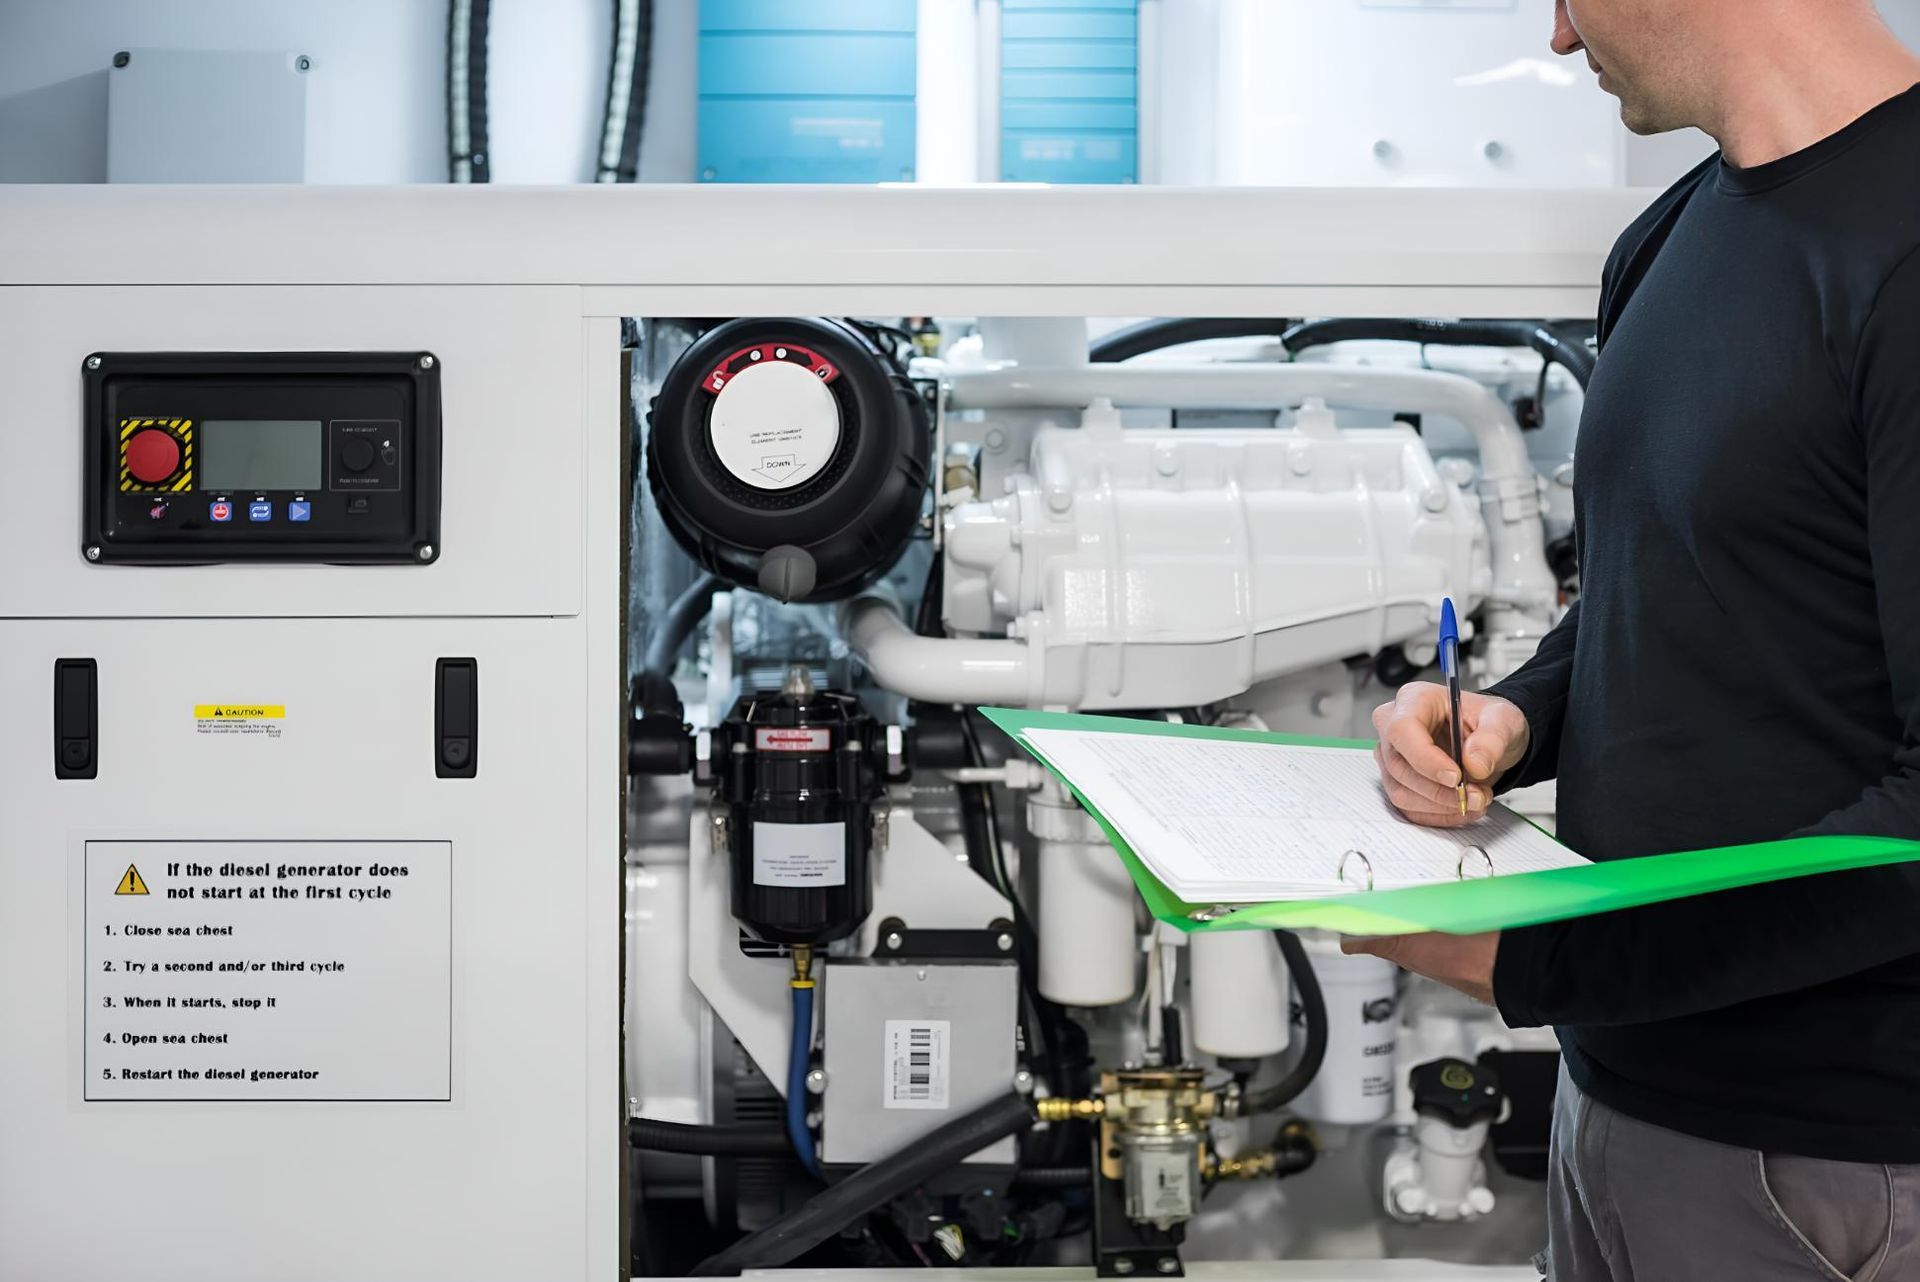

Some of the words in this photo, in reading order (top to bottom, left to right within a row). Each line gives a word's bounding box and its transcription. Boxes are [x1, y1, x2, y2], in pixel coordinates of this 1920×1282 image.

[766, 460, 791, 469] DOWN
[168, 863, 180, 877] If
[186, 863, 213, 877] the
[219, 862, 269, 877] diesel
[277, 863, 362, 880] generator
[369, 863, 409, 877] does
[168, 886, 194, 899] not
[201, 886, 242, 899] start
[249, 886, 265, 899] at
[272, 885, 299, 899] the
[306, 885, 341, 899] first
[349, 885, 392, 902] cycle
[104, 924, 116, 936] 1.
[124, 924, 161, 936] Close
[167, 926, 190, 936] sea
[196, 924, 233, 936] chest
[103, 960, 116, 972] 2.
[123, 960, 146, 974] Try
[151, 963, 159, 972] a
[164, 960, 213, 972] second
[218, 960, 266, 974] and/or
[271, 960, 304, 972] third
[310, 960, 345, 975] cycle
[103, 995, 116, 1008] 3.
[124, 996, 161, 1008] When
[167, 996, 176, 1008] it
[232, 996, 261, 1010] stop
[267, 996, 276, 1008] it
[103, 1032, 116, 1044] 4.
[122, 1032, 157, 1046] Open
[162, 1034, 186, 1044] sea
[191, 1032, 228, 1044] chest
[103, 1068, 116, 1080] 5.
[122, 1068, 172, 1080] Restart
[178, 1068, 200, 1080] the
[204, 1068, 245, 1080] diesel
[250, 1068, 319, 1083] generator
